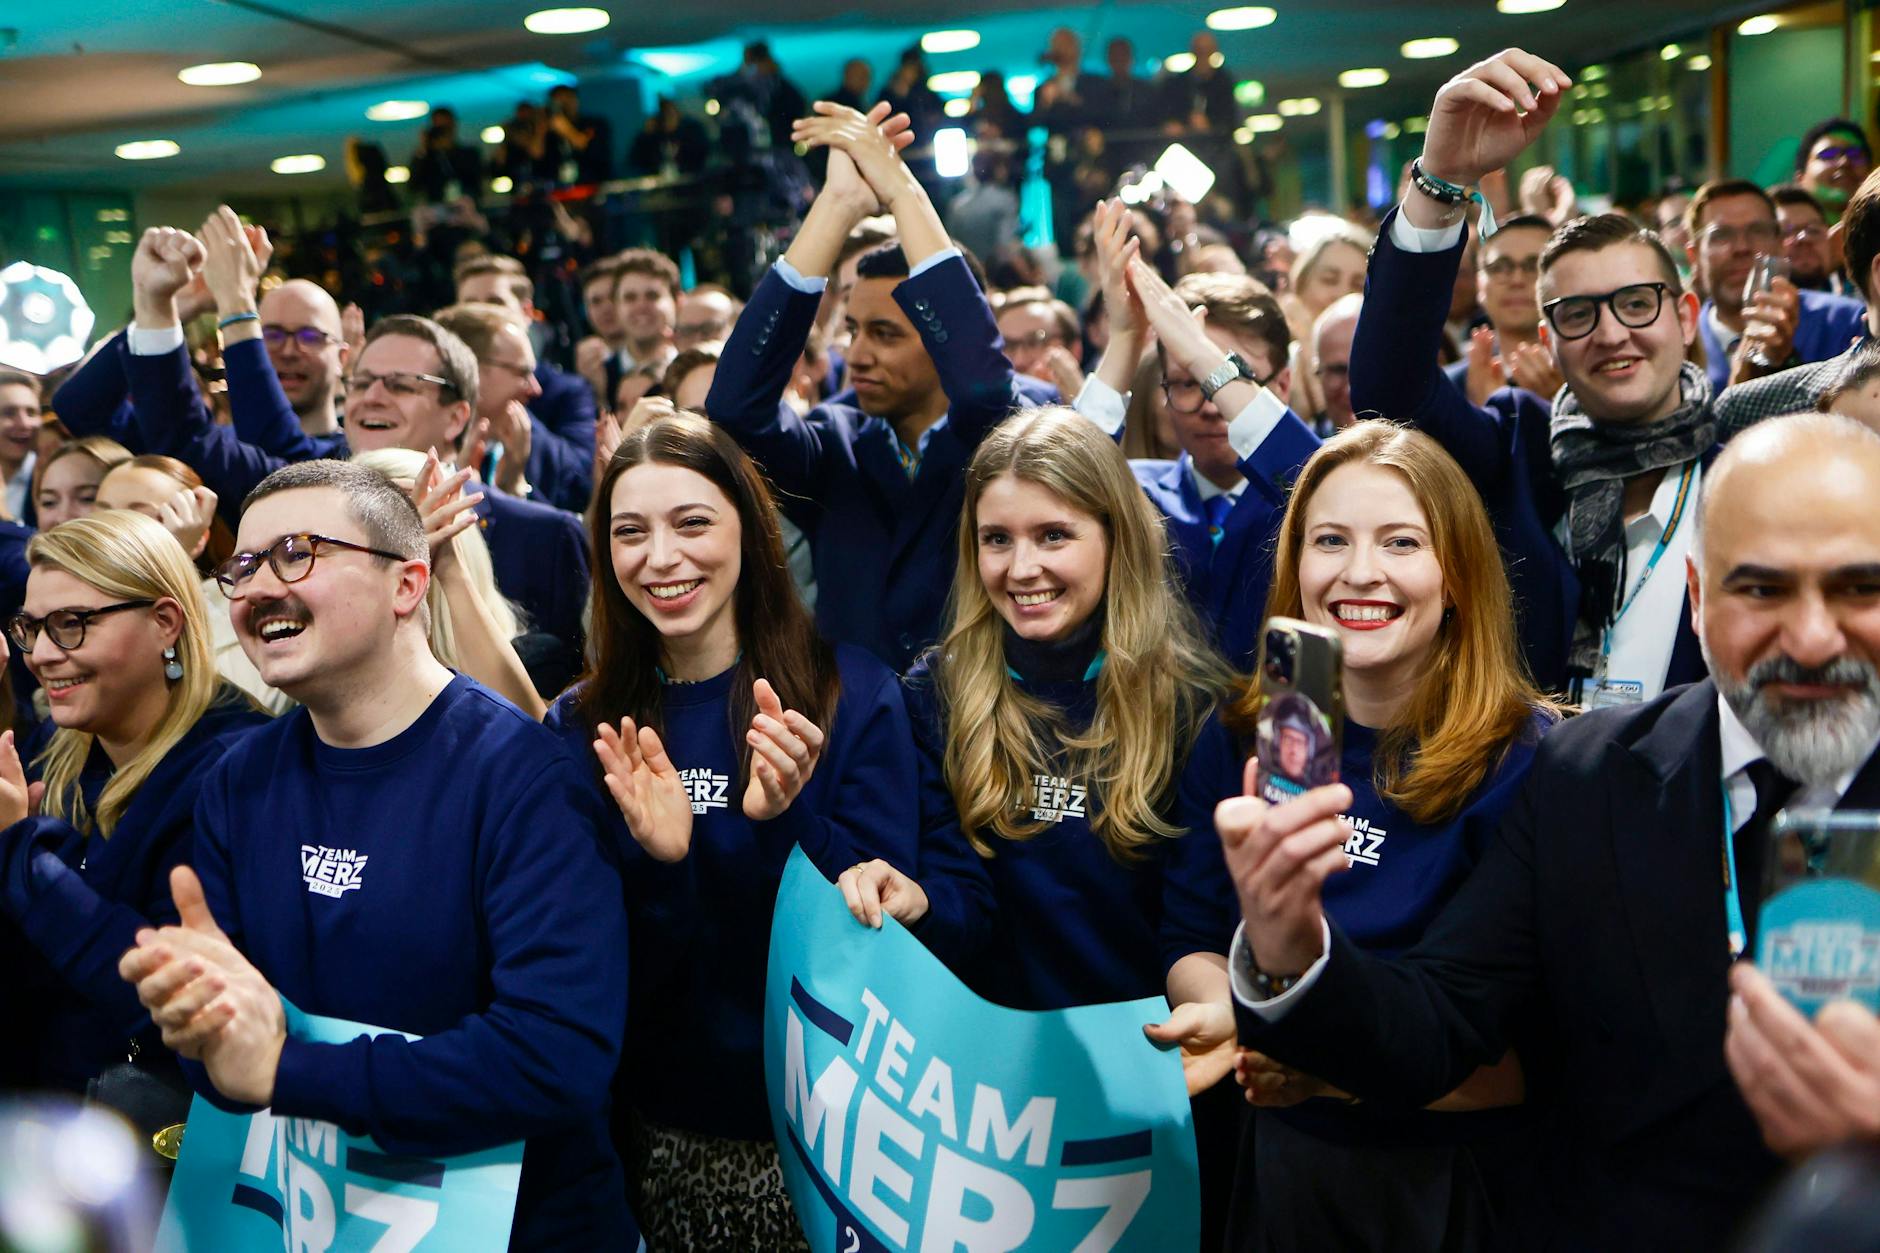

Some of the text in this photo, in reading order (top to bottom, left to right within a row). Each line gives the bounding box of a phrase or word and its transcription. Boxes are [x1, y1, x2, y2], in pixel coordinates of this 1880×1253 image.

[682, 780, 729, 802] ERZ
[318, 845, 357, 863] TEAM
[1344, 829, 1385, 860] RZ
[301, 851, 367, 886] MERZ
[312, 881, 341, 896] 2025
[854, 986, 1057, 1168] TEAM
[784, 1004, 1153, 1253] MERZ
